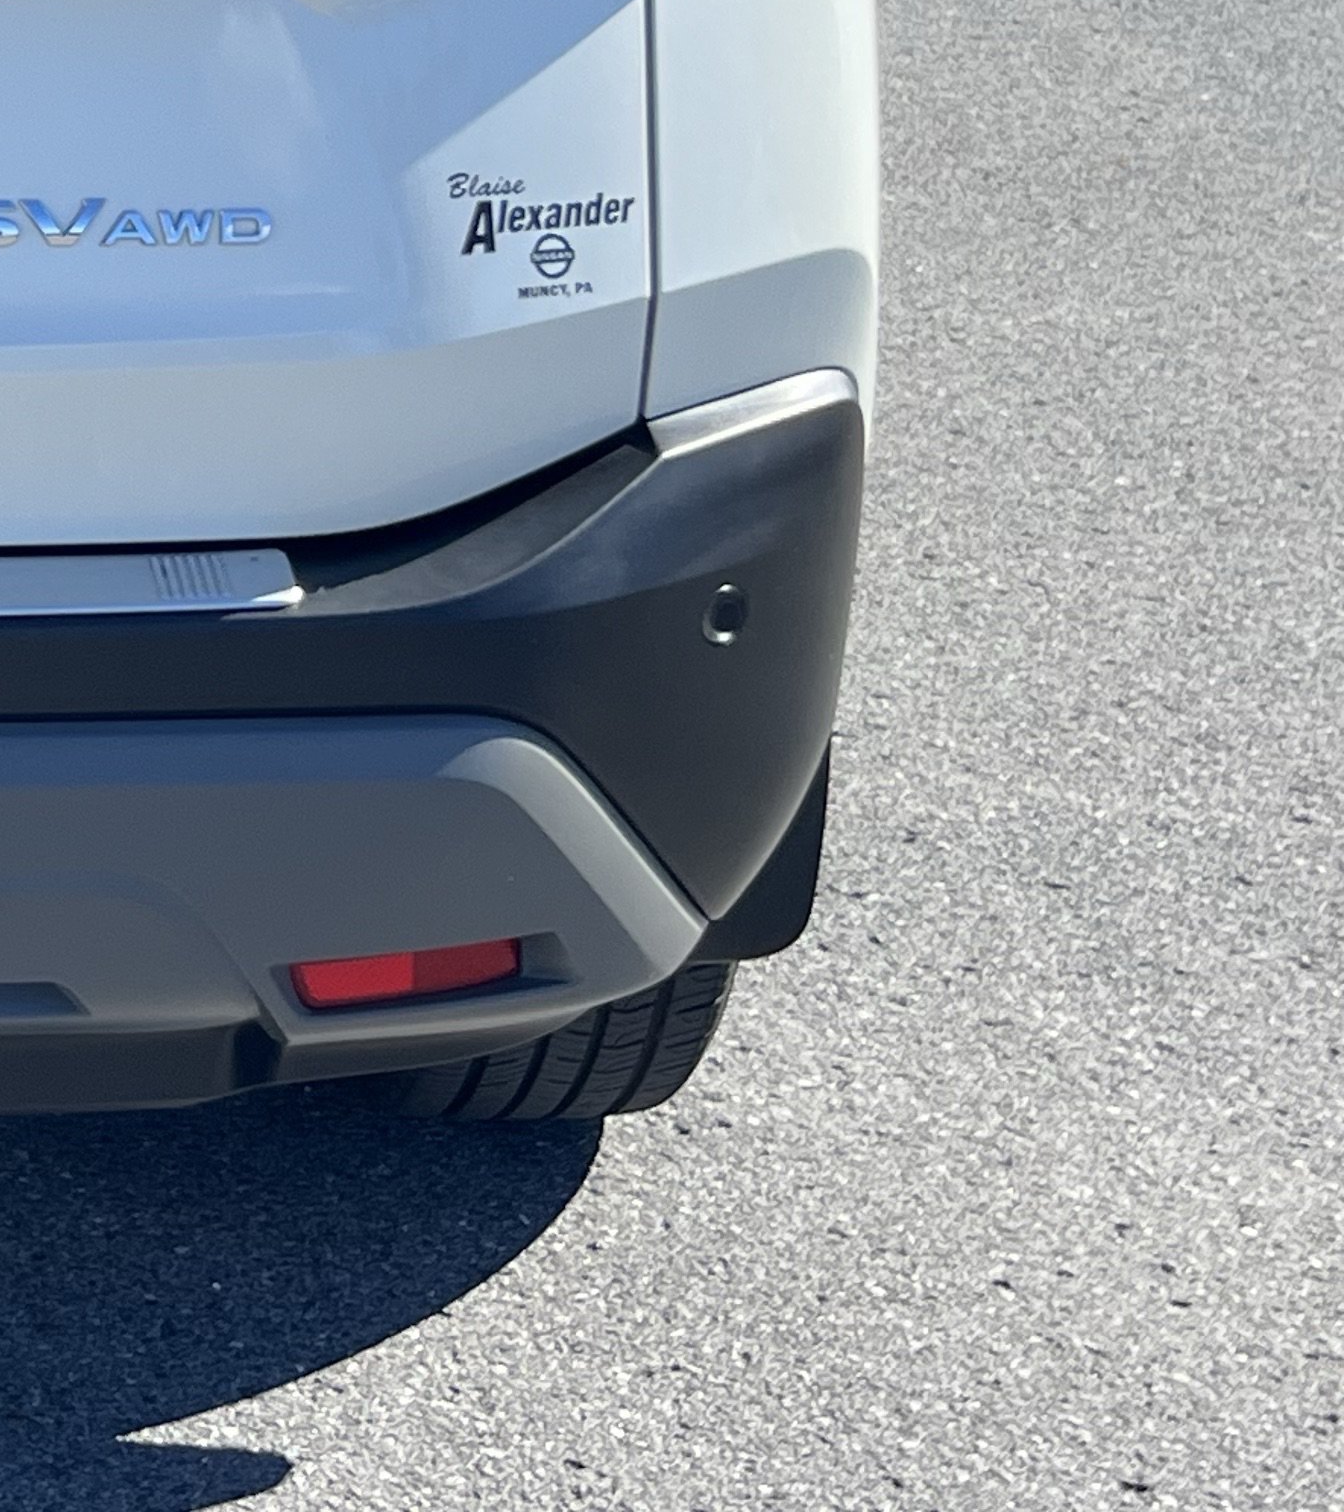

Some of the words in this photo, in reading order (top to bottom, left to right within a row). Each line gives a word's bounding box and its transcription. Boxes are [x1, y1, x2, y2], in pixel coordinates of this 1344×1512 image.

[446, 172, 526, 199] Blaise
[99, 207, 273, 248] AWD
[461, 191, 636, 255] Alexander
[518, 283, 571, 299] MUNCY,
[574, 281, 594, 294] PA
